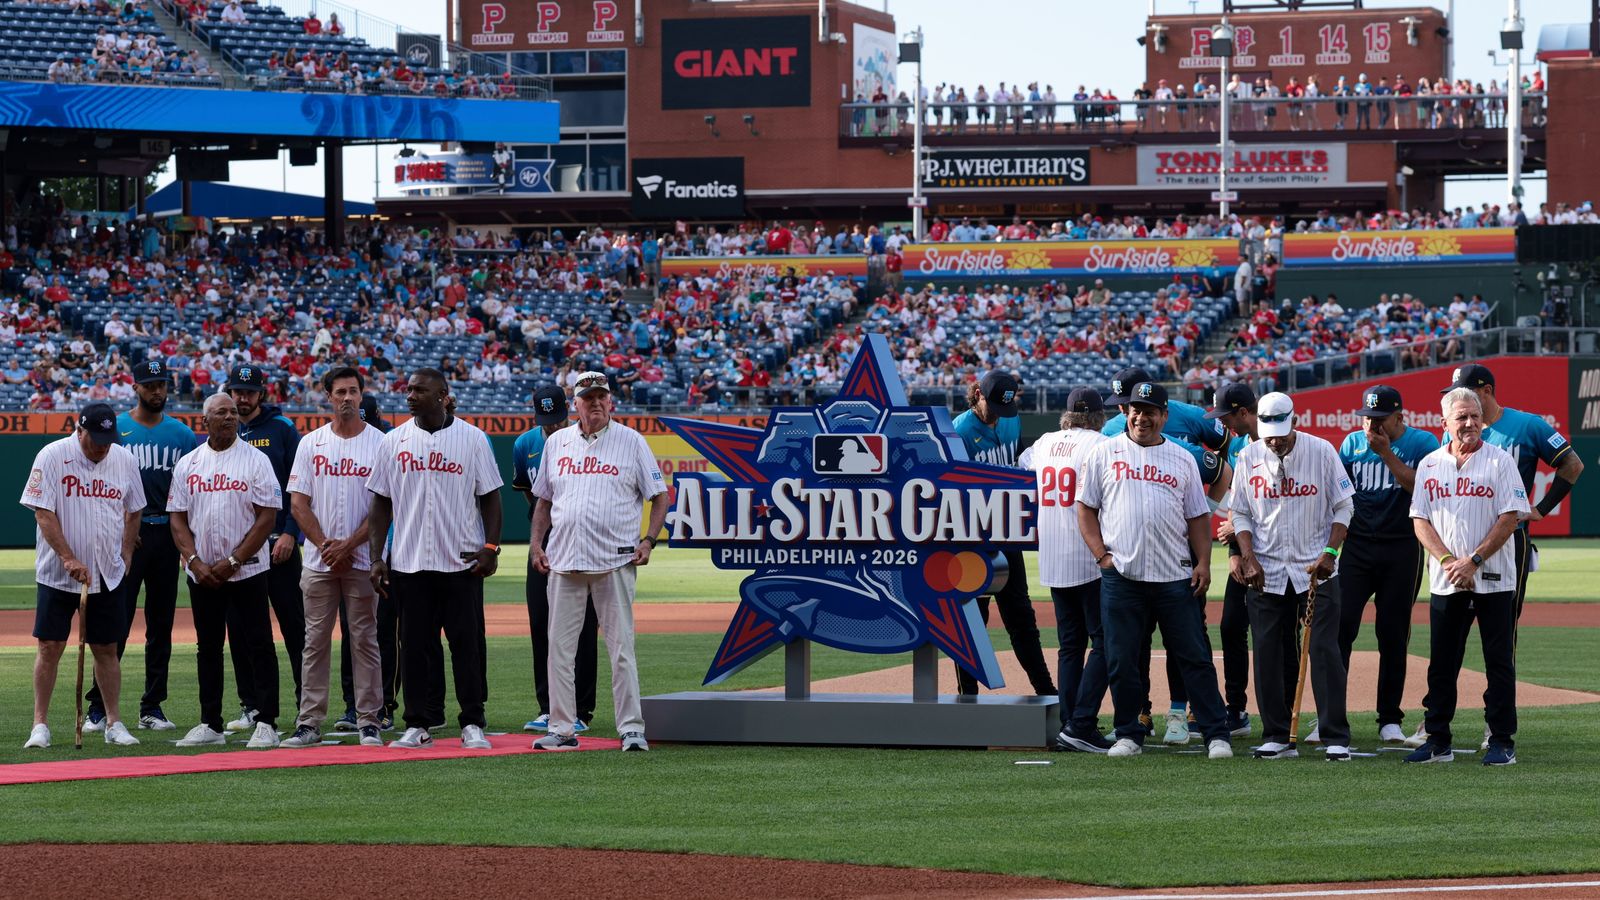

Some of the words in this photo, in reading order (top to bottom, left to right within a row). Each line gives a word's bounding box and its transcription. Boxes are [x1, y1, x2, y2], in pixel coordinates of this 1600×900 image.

[529, 33, 568, 43] THOMPSON
[587, 31, 624, 42] HAMILTON
[1280, 26, 1292, 54] 1
[1319, 24, 1348, 54] 14
[1364, 23, 1391, 51] 15
[674, 47, 797, 77] GIANT
[1156, 152, 1222, 167] TONY
[1234, 149, 1328, 166] LUKE'S
[665, 180, 737, 198] Fanatics
[940, 179, 966, 187] PUB
[978, 178, 1064, 186] RESTAURANT
[1165, 176, 1183, 184] The
[1187, 176, 1209, 184] Real
[1244, 175, 1254, 183] of
[1291, 175, 1320, 184] Philly
[1084, 245, 1170, 272] Surfside
[1332, 235, 1415, 261] Surfside
[920, 247, 1004, 274] Surfside
[1049, 442, 1077, 457] KRUK
[397, 451, 463, 475] Phillies
[557, 456, 619, 477] Phillies
[1112, 461, 1178, 488] Phillies
[62, 475, 122, 500] Phillies
[187, 473, 248, 495] Phillies
[1041, 466, 1077, 507] 29
[1249, 475, 1318, 499] Phillies
[1424, 477, 1494, 502] Phillies
[665, 478, 763, 540] ALL
[770, 477, 896, 542] STAR
[901, 478, 1036, 542] GAME
[721, 549, 856, 564] PHILADELPHIA
[872, 549, 918, 565] 2026
